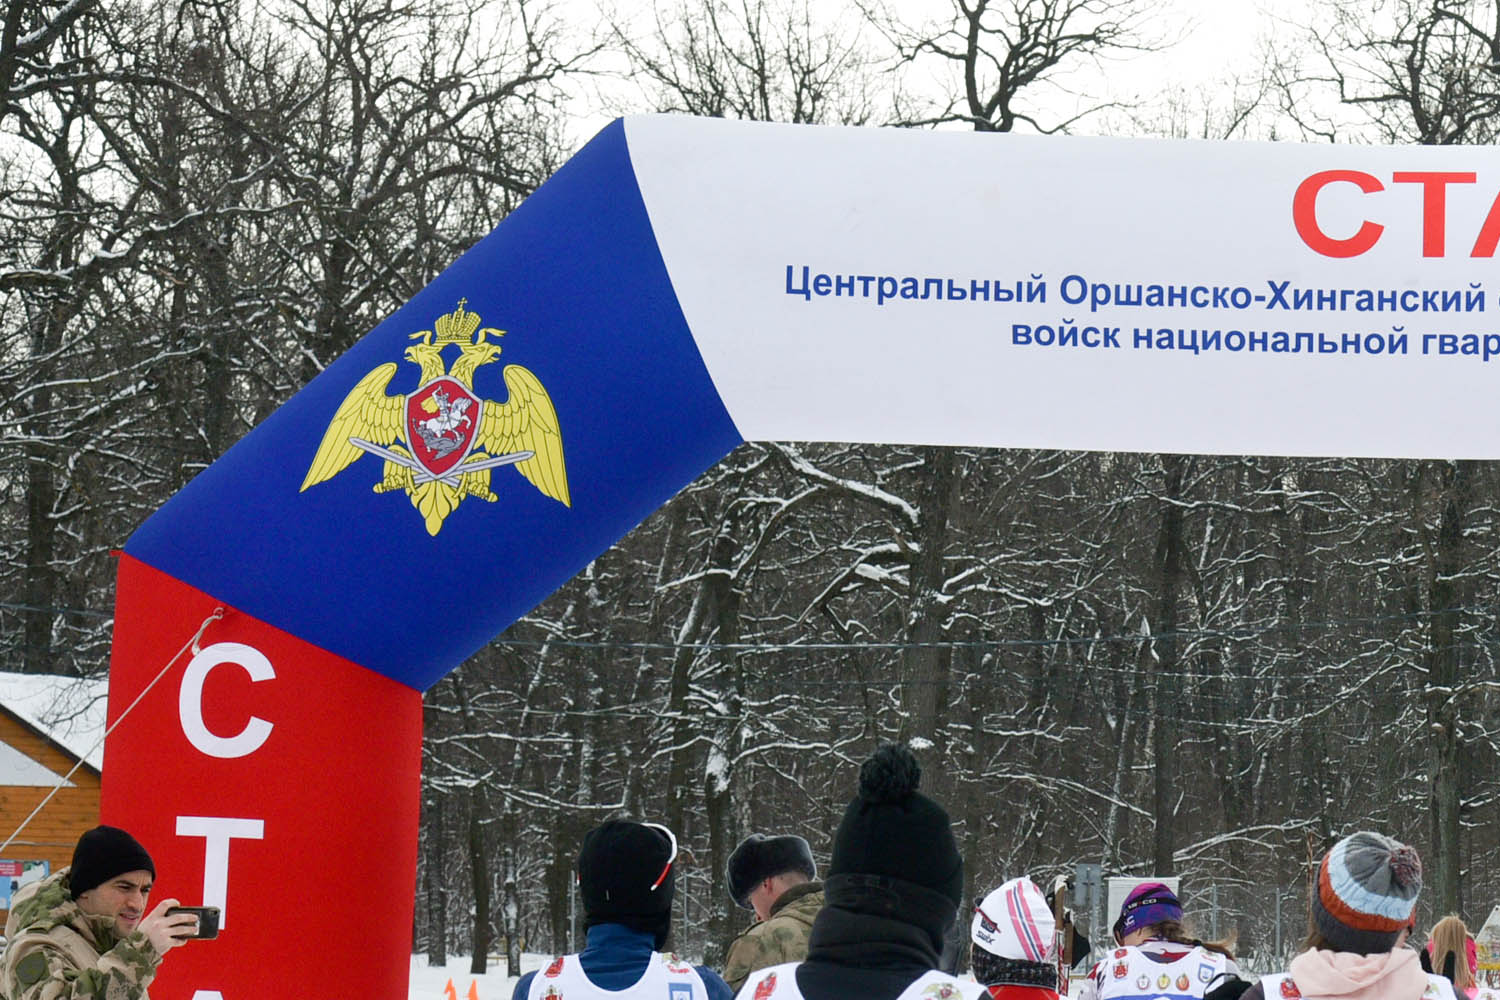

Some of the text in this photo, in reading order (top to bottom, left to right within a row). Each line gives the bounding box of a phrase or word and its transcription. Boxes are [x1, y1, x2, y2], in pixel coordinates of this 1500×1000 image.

[785, 265, 1047, 306] Центральный
[1060, 274, 1486, 314] Оршанско-Хинганский
[1012, 319, 1121, 348] войск
[1133, 327, 1408, 356] национальной
